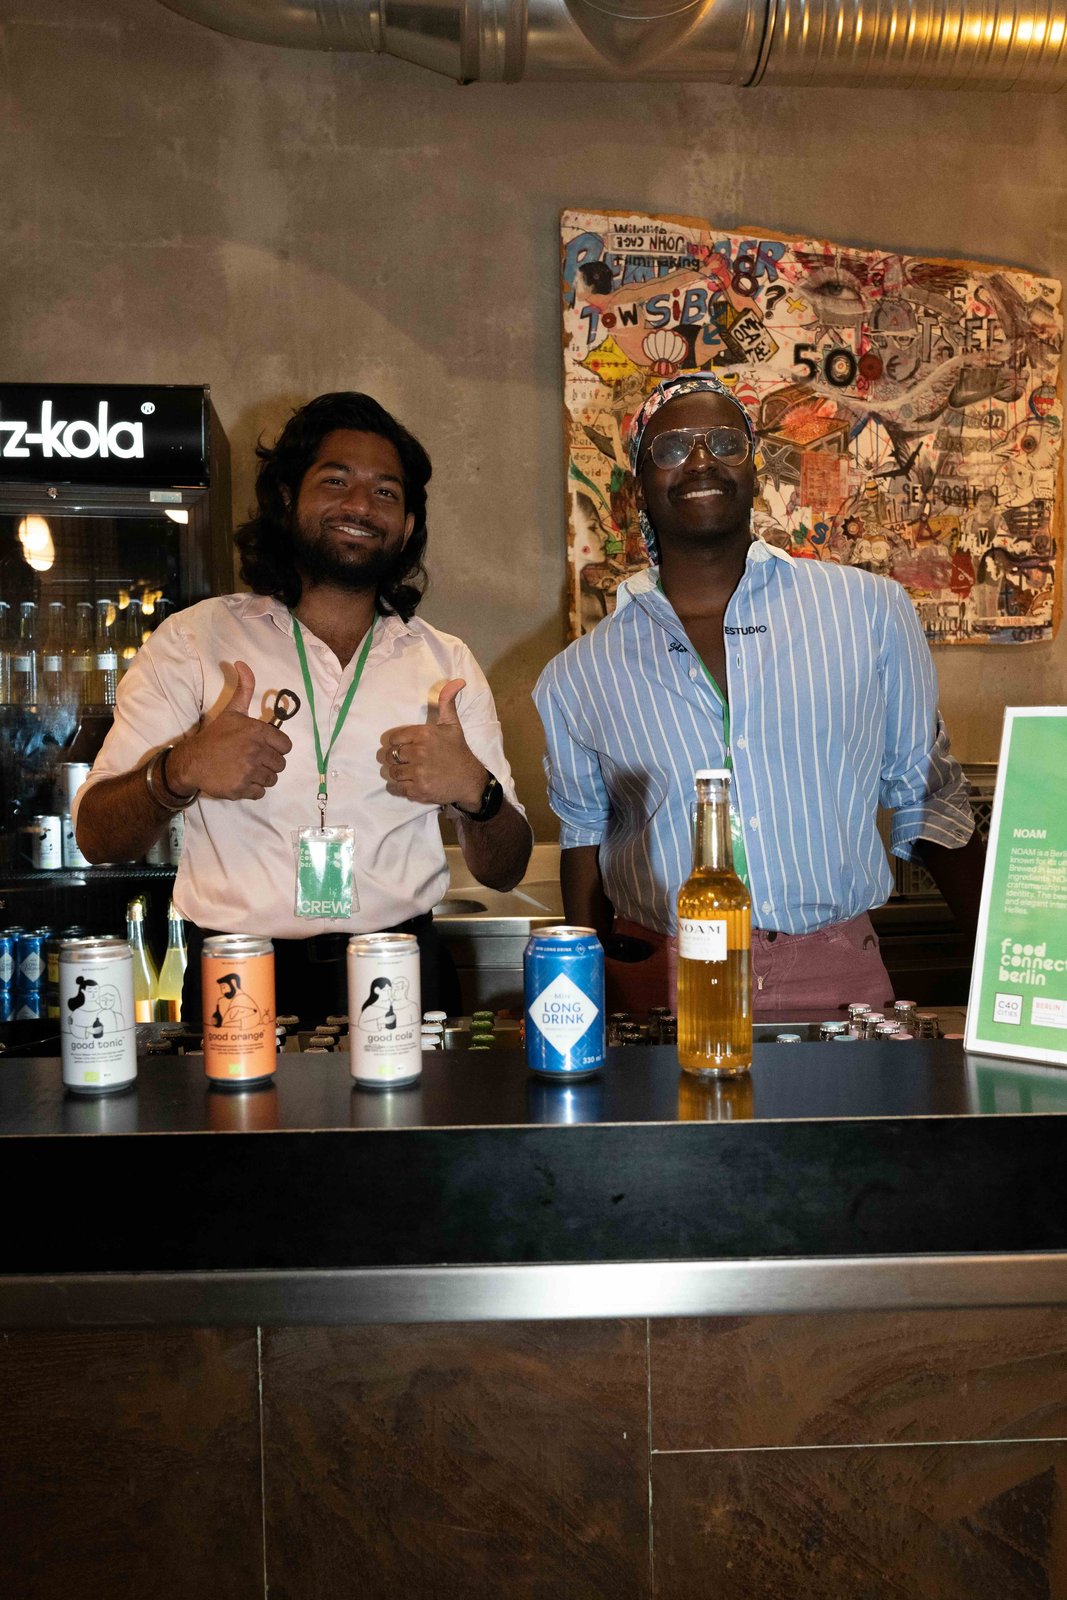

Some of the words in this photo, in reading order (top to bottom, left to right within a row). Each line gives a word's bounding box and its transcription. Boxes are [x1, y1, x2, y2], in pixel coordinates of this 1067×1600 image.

[616, 236, 644, 248] CAGE
[649, 236, 684, 252] JOHN
[724, 625, 767, 635] ESTUDIO
[1013, 828, 1047, 839] NOAM
[1011, 848, 1036, 856] NOAM
[300, 900, 348, 914] CREW
[1001, 937, 1047, 958] food
[998, 965, 1046, 986] berlin
[544, 1002, 581, 1013] LONG
[998, 1000, 1019, 1010] C40
[542, 1013, 585, 1024] DRINK
[207, 1031, 228, 1042] good
[231, 1029, 264, 1042] orange
[367, 1032, 392, 1044] good
[395, 1031, 413, 1042] cola
[71, 1041, 95, 1051] good
[98, 1038, 123, 1049] tonic
